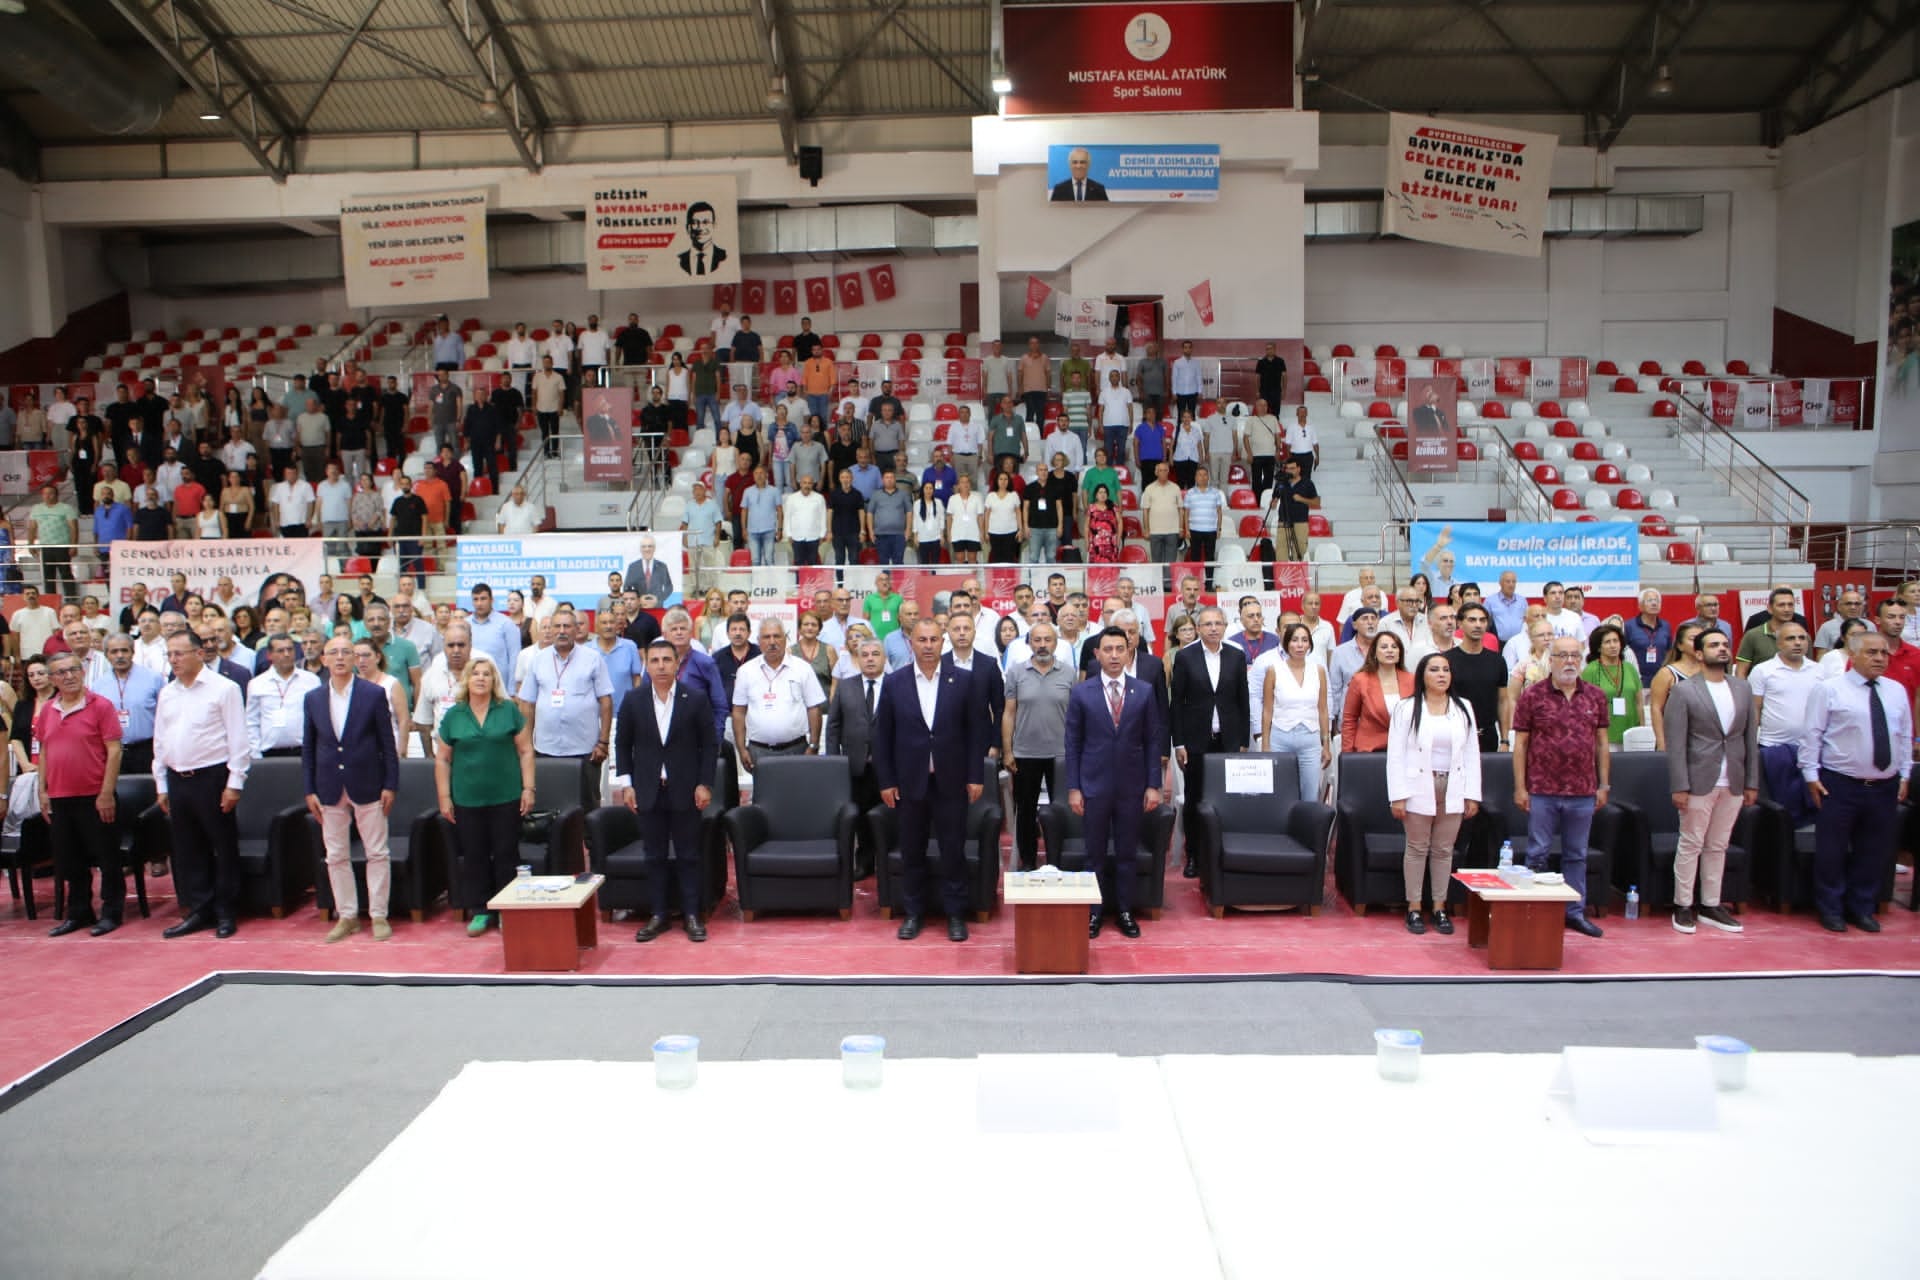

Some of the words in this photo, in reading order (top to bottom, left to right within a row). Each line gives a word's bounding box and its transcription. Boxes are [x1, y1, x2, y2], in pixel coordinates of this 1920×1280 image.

[1069, 71, 1125, 83] MUSTAFA
[1128, 69, 1169, 81] KEMAL
[1171, 66, 1227, 80] ATATÜRK
[1113, 86, 1140, 99] Spor
[1143, 85, 1182, 97] Salonu
[1408, 136, 1523, 167] BAYRAKLI'DA
[1405, 151, 1476, 173] GELECEK
[1108, 168, 1154, 177] AYDINLIK
[1424, 168, 1496, 192] GELECEK
[1401, 180, 1473, 205] BİZİMLE
[1478, 195, 1518, 212] VAR!
[1497, 535, 1545, 551] DEMİR
[1547, 535, 1579, 551] GİBİ
[1581, 534, 1632, 551] İRADE,
[120, 547, 194, 560] GENÇLİĞİN
[1466, 555, 1526, 567] BAYRAKLI
[1529, 552, 1556, 568] İÇİN
[1232, 578, 1256, 588] CHP
[753, 587, 777, 597] CHP
[1134, 586, 1157, 596] CHP
[1280, 588, 1305, 599] CHP
